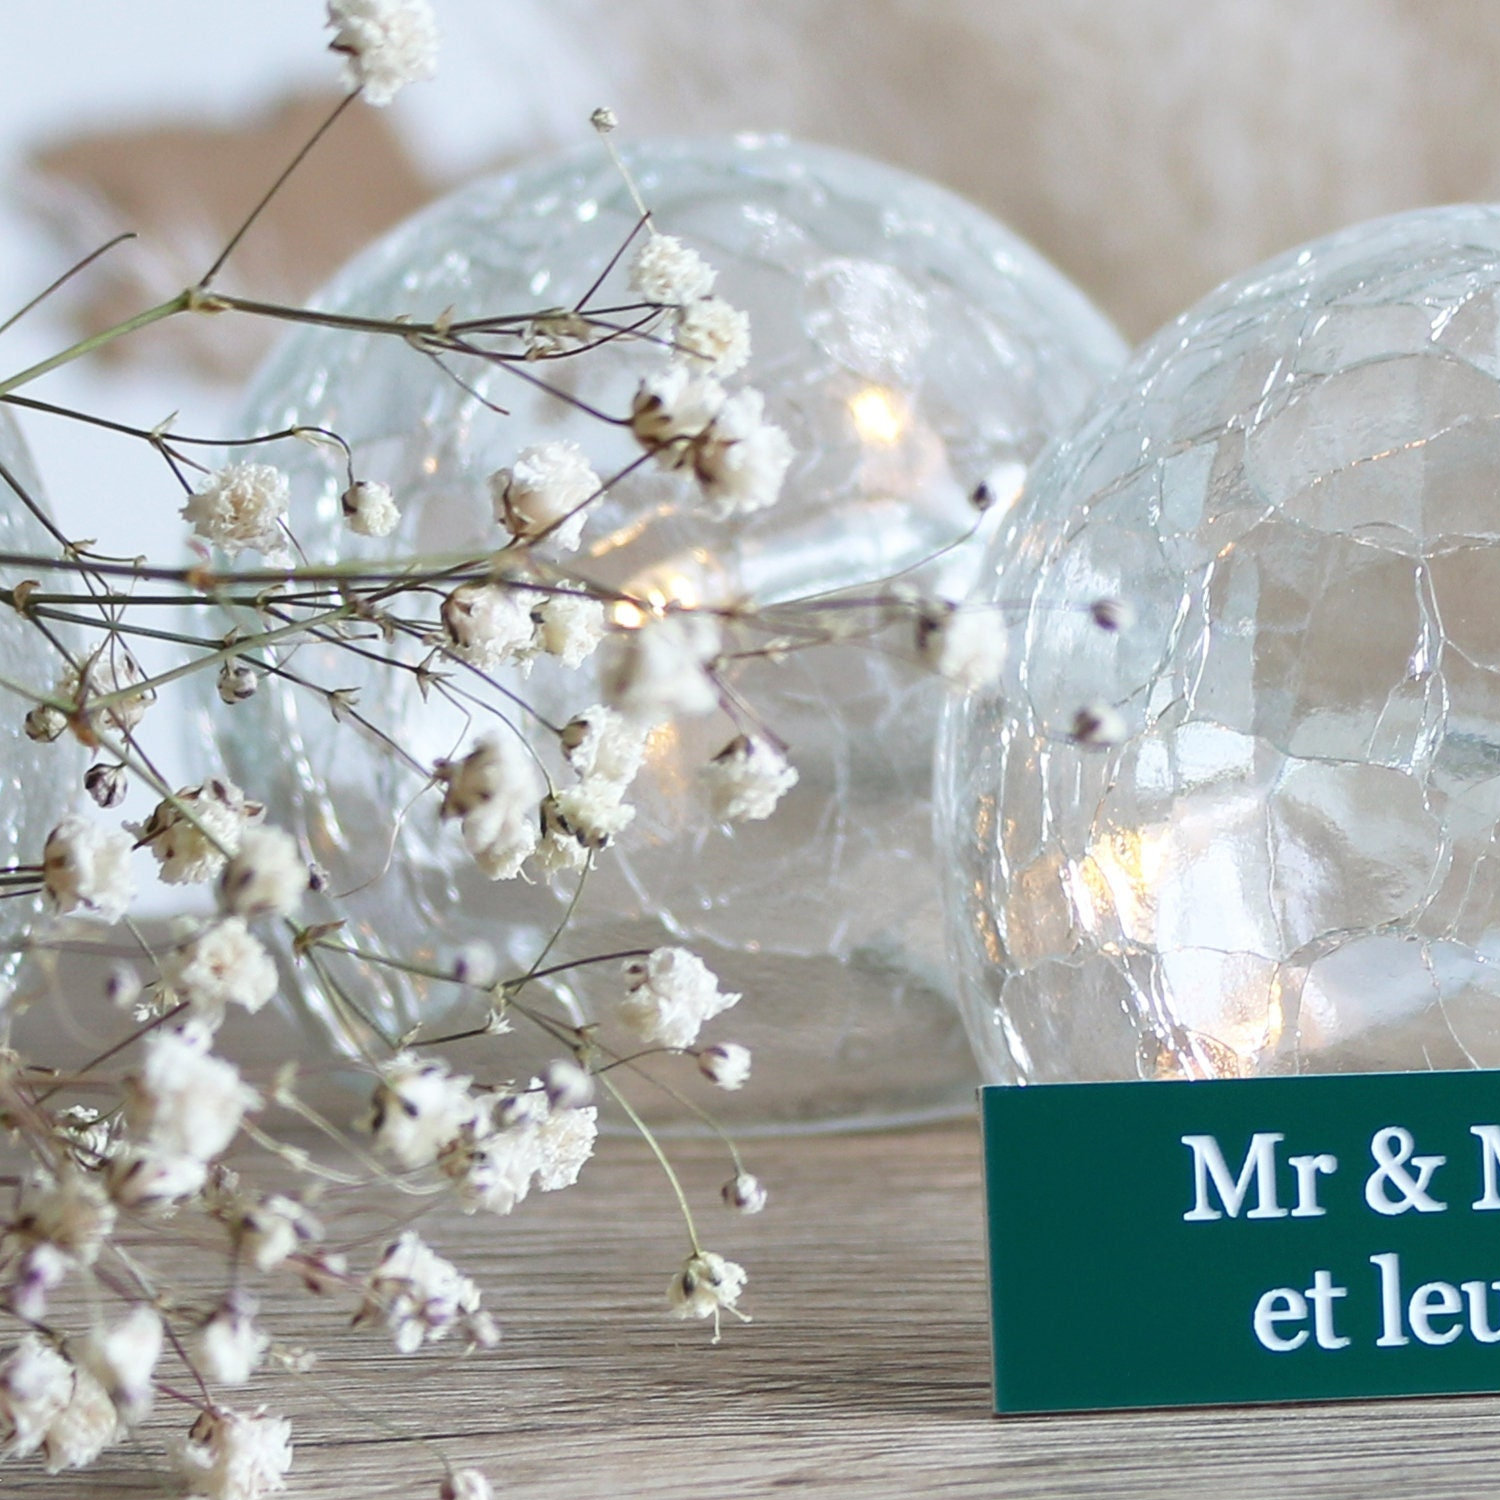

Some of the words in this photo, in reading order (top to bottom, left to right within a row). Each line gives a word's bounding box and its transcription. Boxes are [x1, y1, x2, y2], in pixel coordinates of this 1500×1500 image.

[1180, 1132, 1337, 1221] Mr
[1364, 1125, 1448, 1216] &
[1253, 1270, 1350, 1352] et
